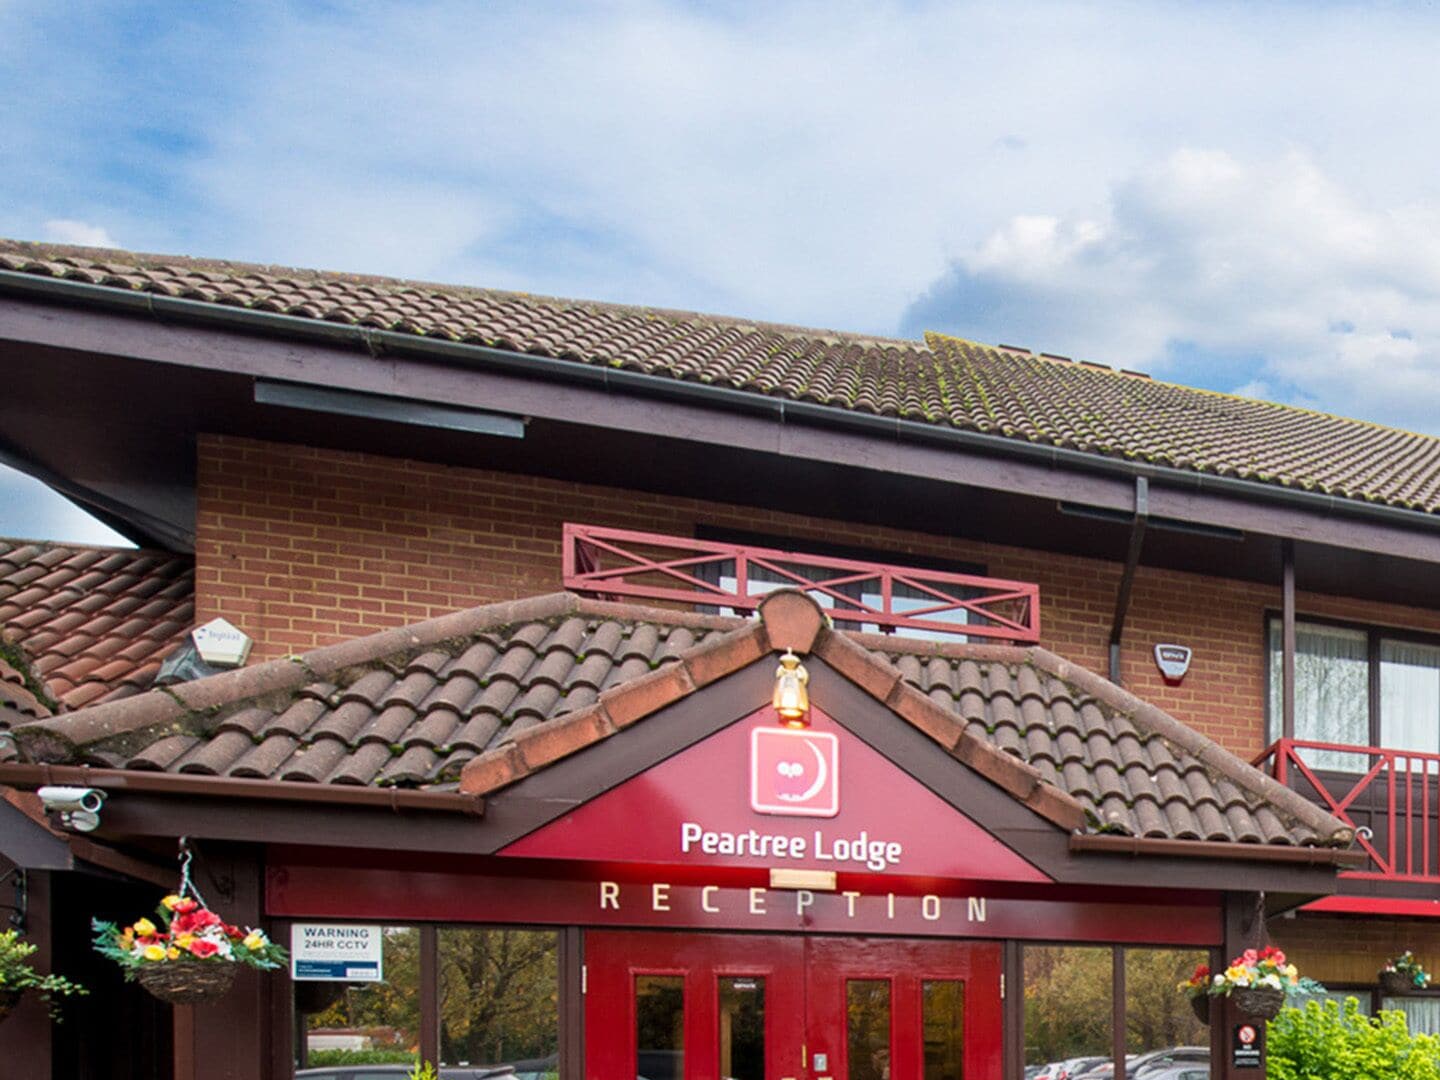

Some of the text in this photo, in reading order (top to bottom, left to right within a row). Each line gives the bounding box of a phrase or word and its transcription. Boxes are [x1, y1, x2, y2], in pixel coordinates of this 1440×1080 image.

[681, 823, 902, 871] Peartree Lodge
[600, 881, 986, 922] RECEPTION
[304, 927, 370, 938] WARNING
[304, 939, 369, 950] 24HR CCTV
